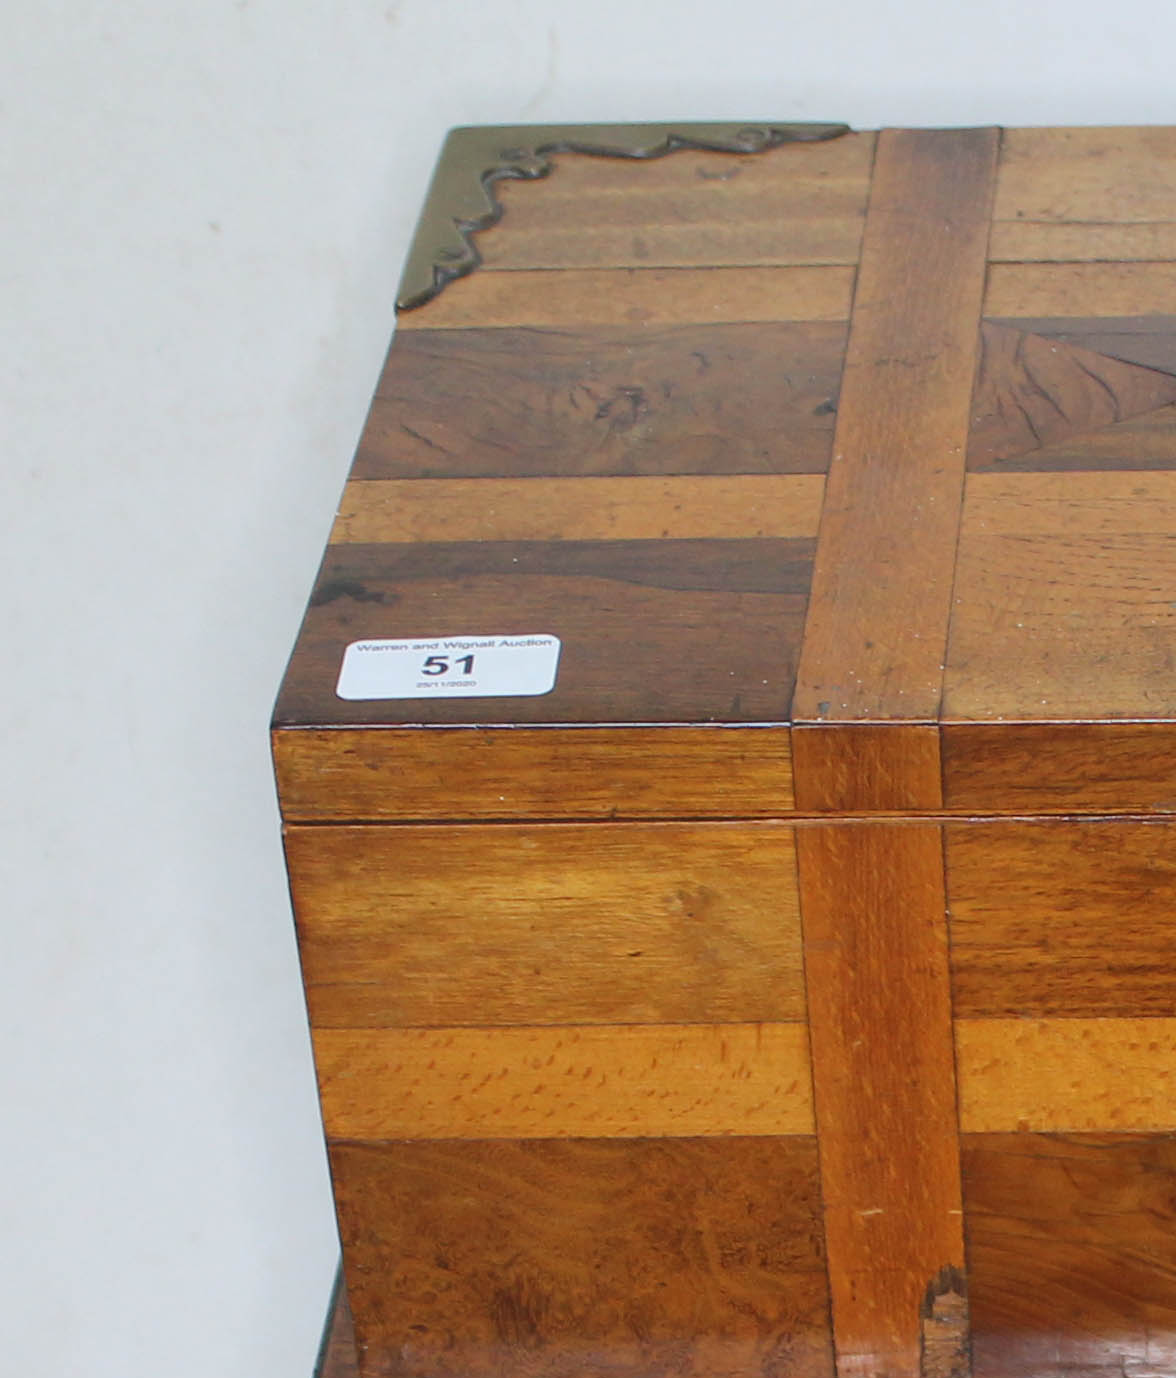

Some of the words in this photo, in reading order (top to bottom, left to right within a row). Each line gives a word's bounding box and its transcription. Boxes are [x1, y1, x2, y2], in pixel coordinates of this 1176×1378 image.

[357, 643, 408, 652] Warren
[412, 642, 439, 650] and
[443, 640, 495, 650] Wignall
[499, 639, 552, 648] Auction
[421, 654, 475, 676] 51
